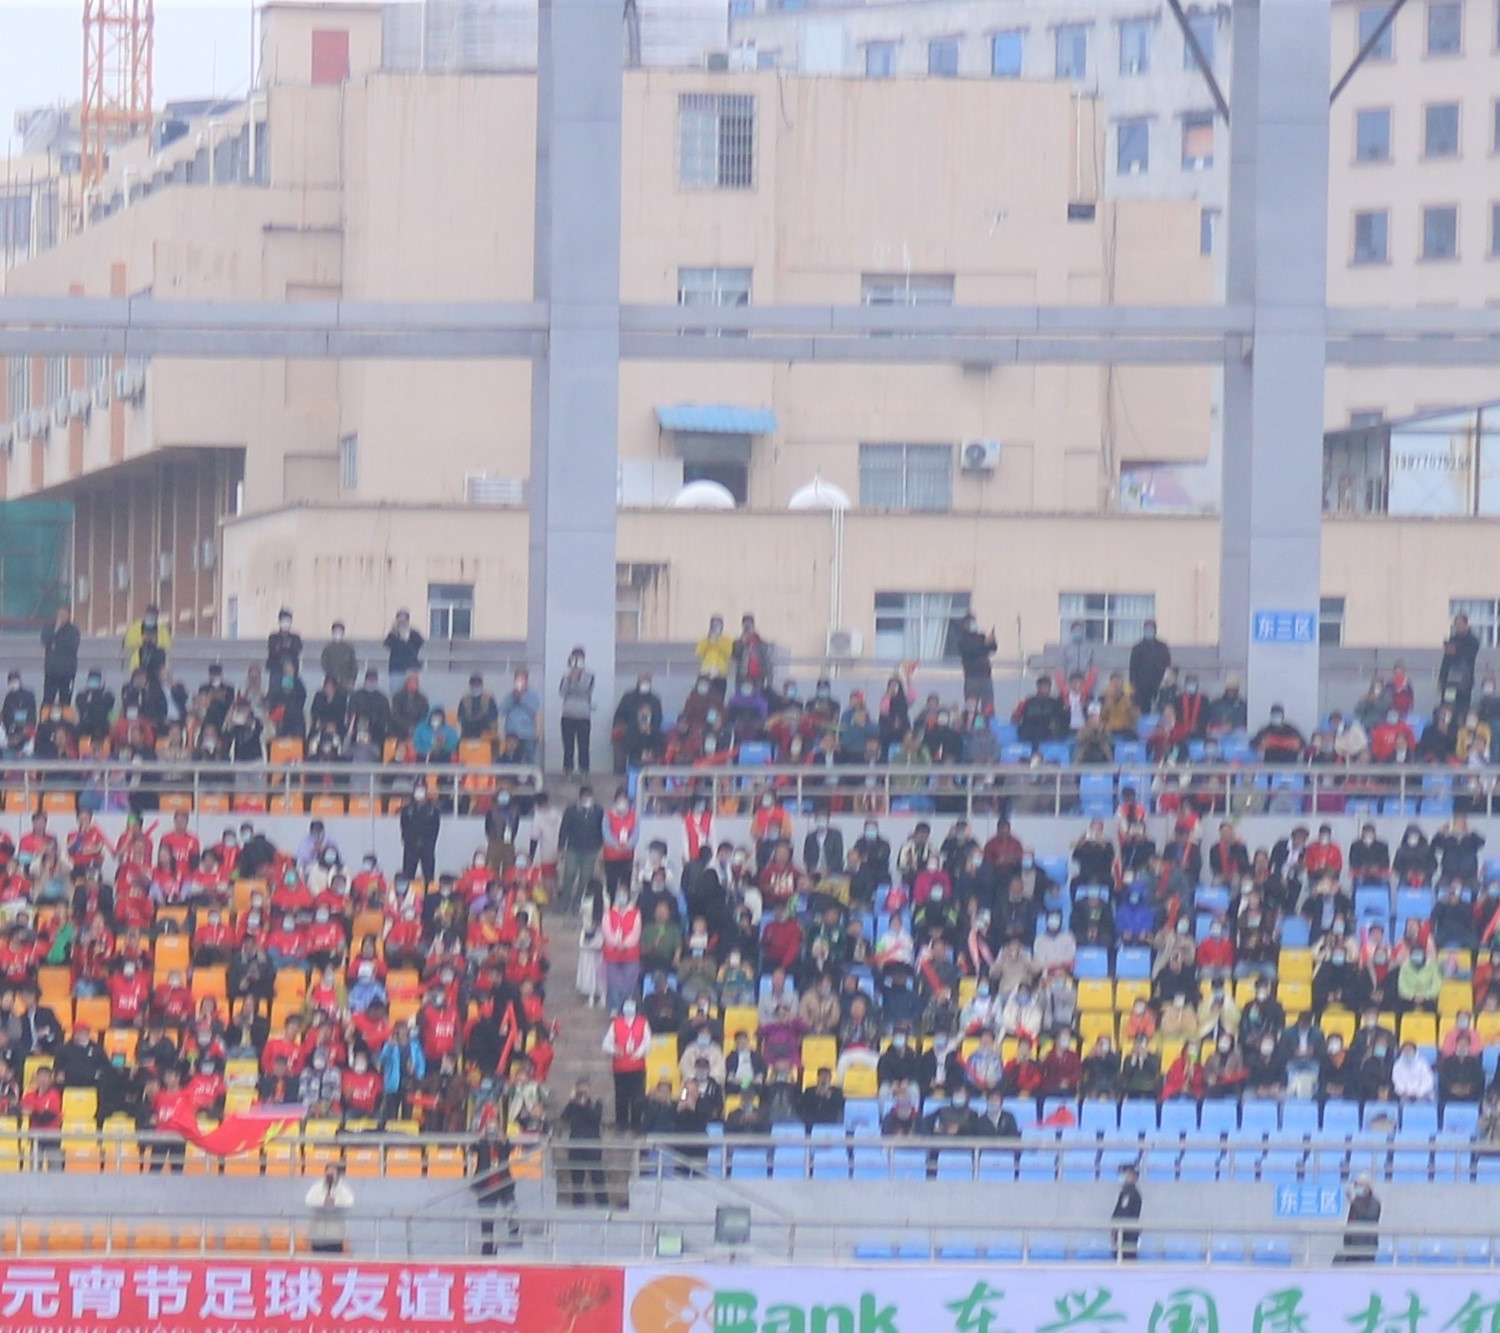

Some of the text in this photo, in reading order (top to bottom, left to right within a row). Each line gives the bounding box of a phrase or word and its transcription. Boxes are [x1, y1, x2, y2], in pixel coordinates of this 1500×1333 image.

[1257, 615, 1312, 640] 东三区
[1279, 1187, 1340, 1213] 东三区
